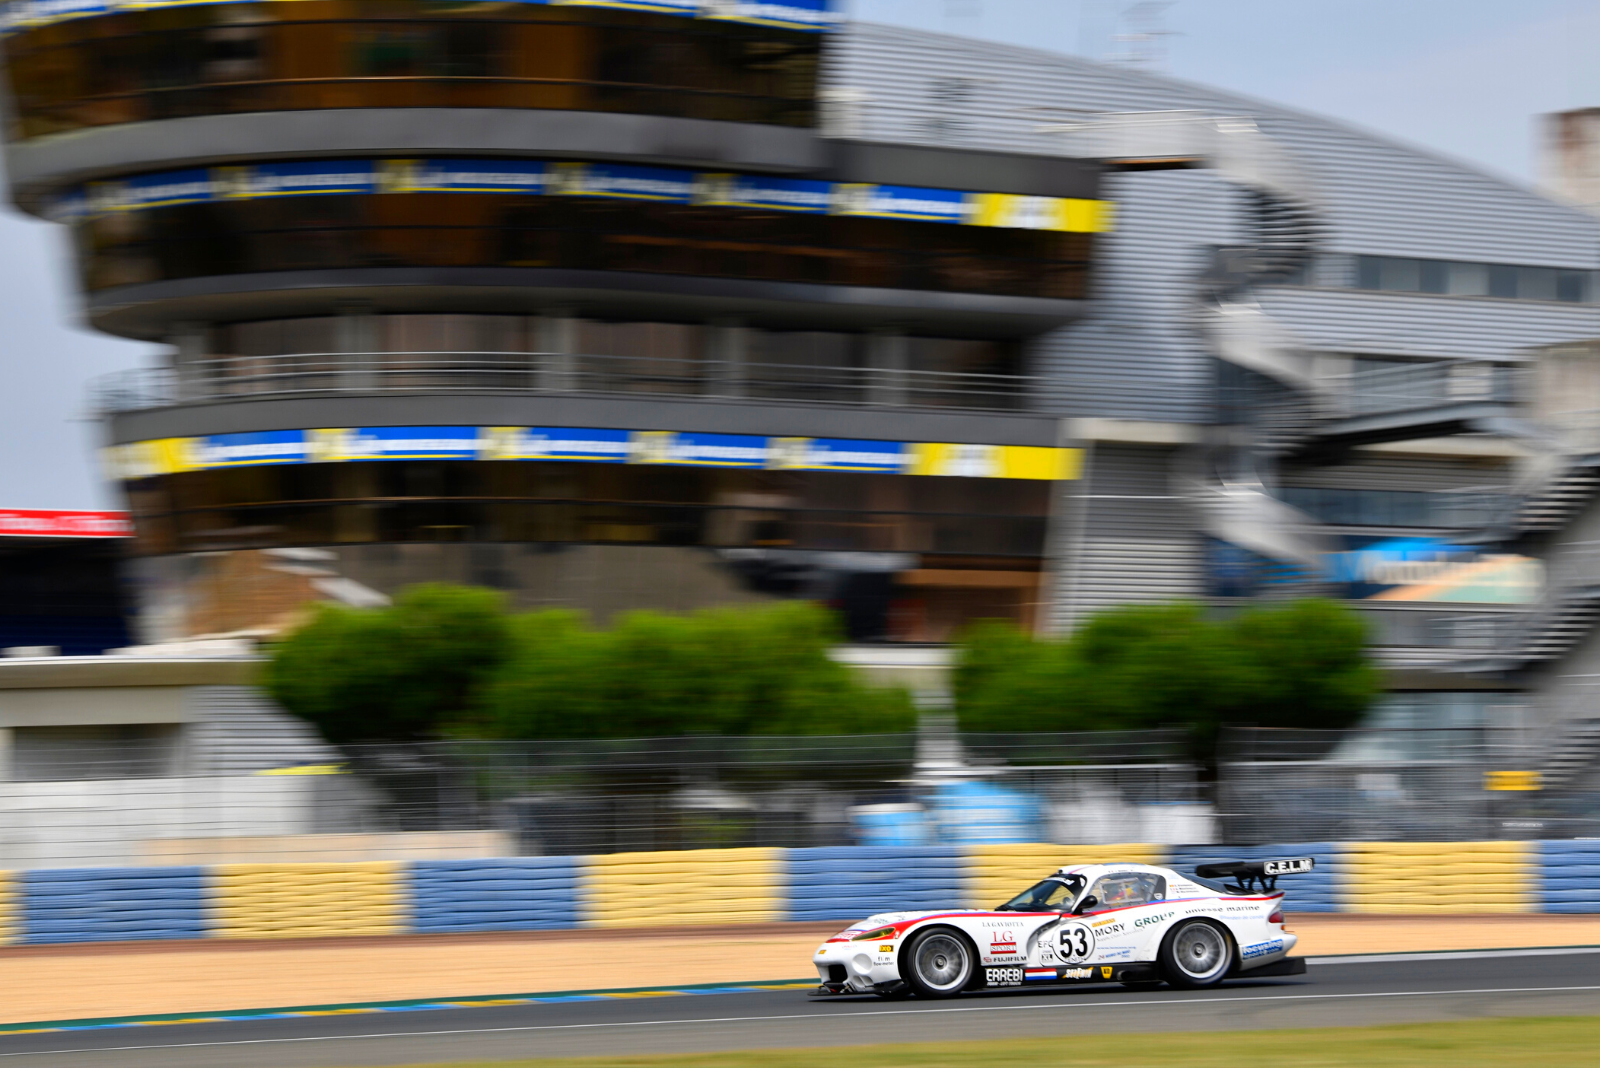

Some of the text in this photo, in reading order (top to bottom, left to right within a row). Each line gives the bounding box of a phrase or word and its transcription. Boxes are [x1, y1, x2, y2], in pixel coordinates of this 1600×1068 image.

[1095, 923, 1125, 937] MORY
[1134, 911, 1175, 927] GROUP
[993, 931, 1014, 942] LG
[1060, 928, 1088, 958] 53
[986, 968, 1023, 982] ERREBI
